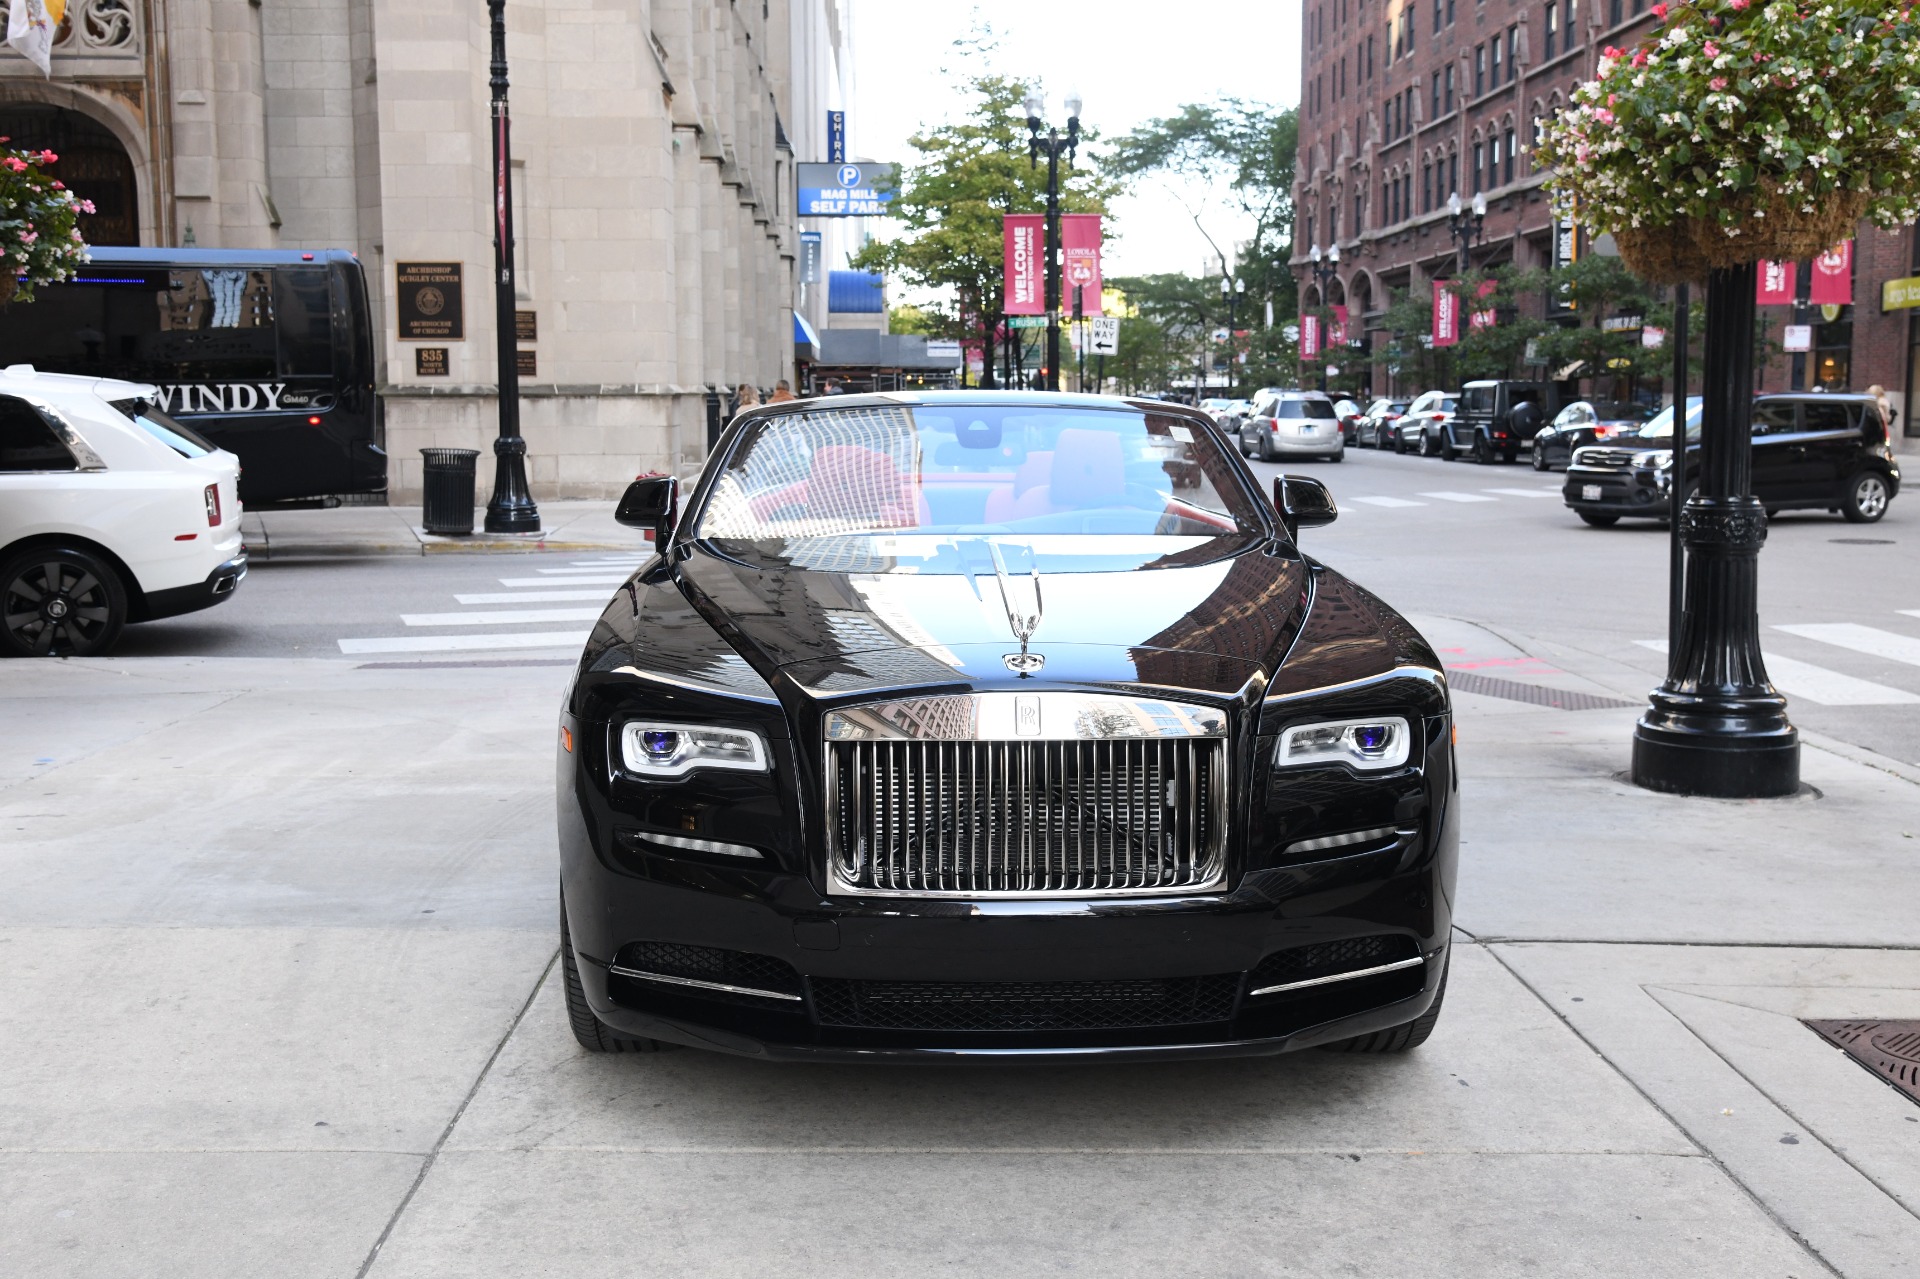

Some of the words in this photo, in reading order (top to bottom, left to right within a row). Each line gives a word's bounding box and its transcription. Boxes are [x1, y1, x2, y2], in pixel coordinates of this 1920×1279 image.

[843, 168, 857, 184] P
[820, 189, 847, 199] MAG
[850, 189, 878, 199] MILE
[810, 201, 846, 213] SELF
[1067, 248, 1096, 256] LOYOLA
[1014, 226, 1027, 303] WELCOME
[1095, 320, 1115, 329] ONE
[1094, 330, 1115, 339] WAY
[422, 350, 443, 361] 835
[147, 383, 286, 412] WINDY
